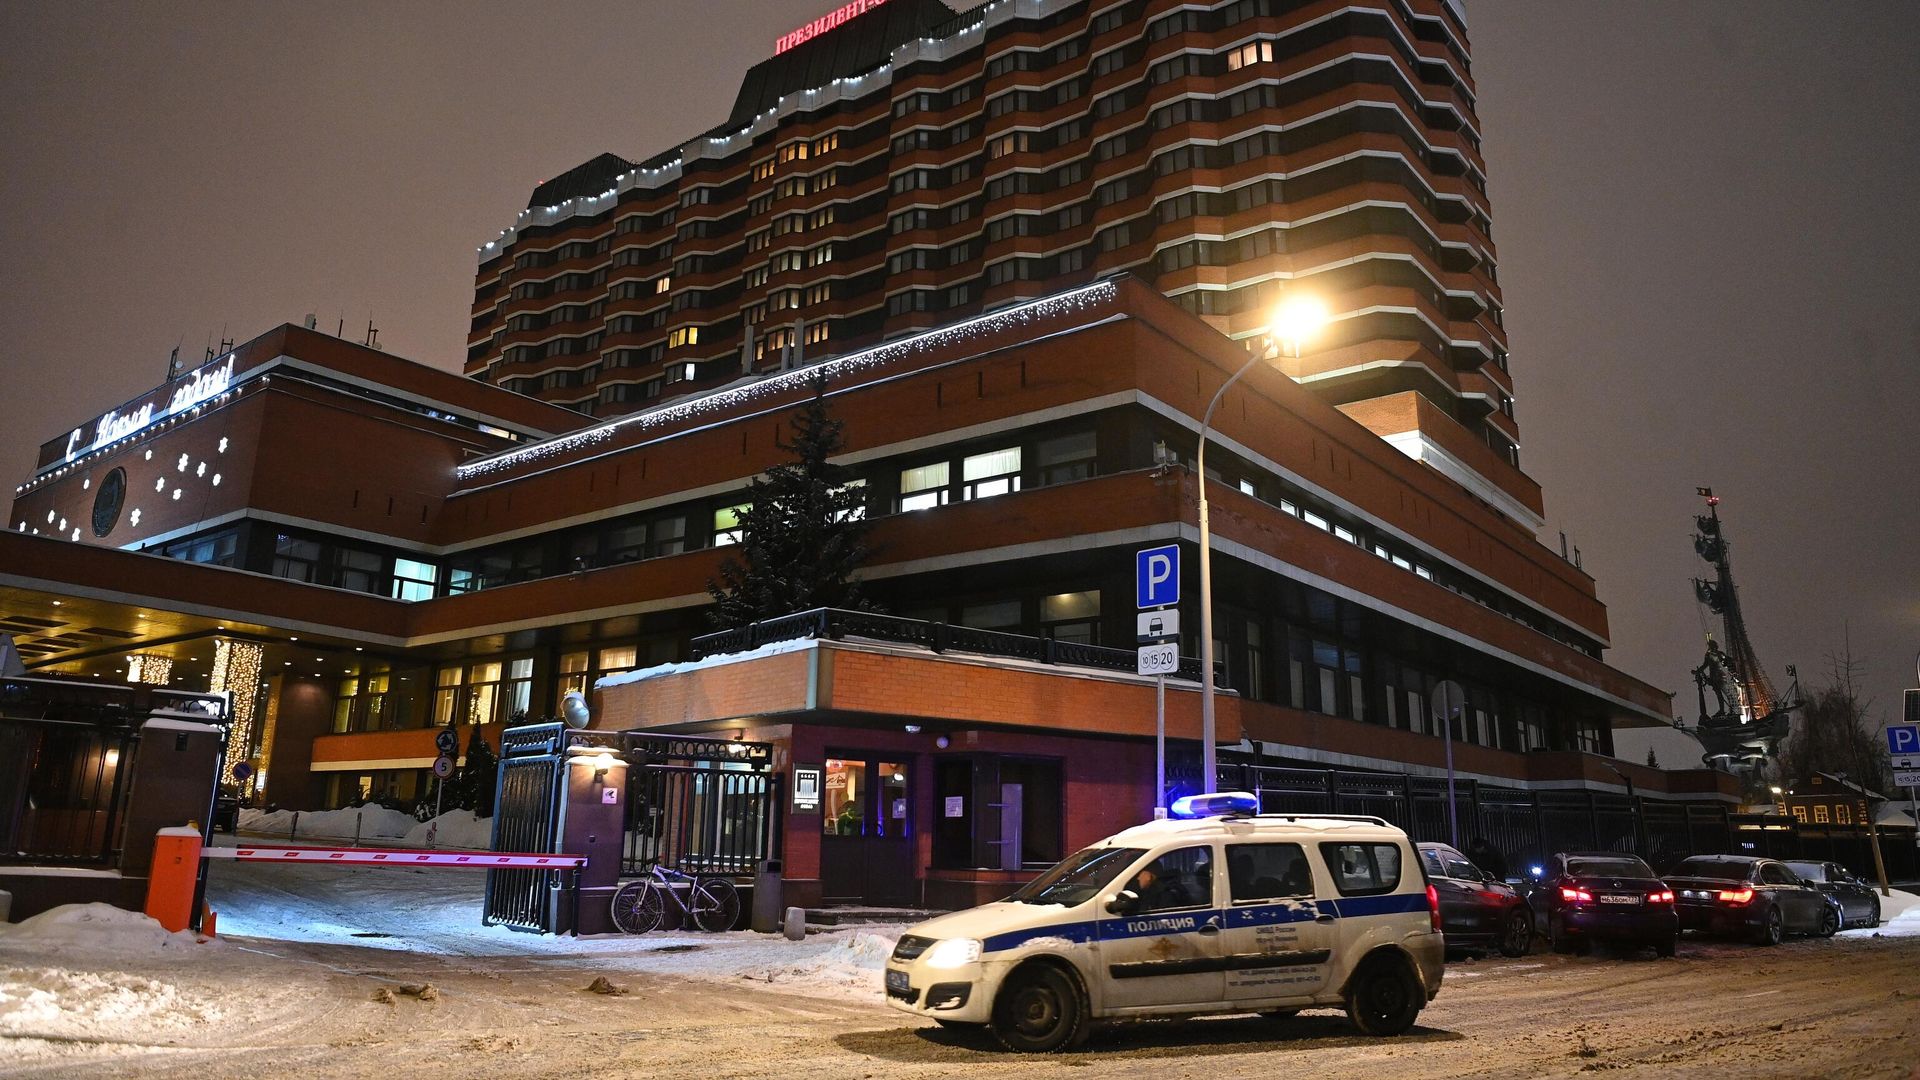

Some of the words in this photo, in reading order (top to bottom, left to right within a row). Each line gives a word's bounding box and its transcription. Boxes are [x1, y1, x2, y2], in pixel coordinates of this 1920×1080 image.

[774, 0, 887, 56] ПРЕЗИДЕНТ-
[1148, 554, 1171, 601] P
[1142, 656, 1149, 665] 10
[1151, 654, 1159, 665] 15
[1161, 651, 1173, 665] 20
[1895, 729, 1913, 751] P
[441, 762, 447, 772] 5
[1127, 917, 1196, 933] ПОЛИЦИЯ
